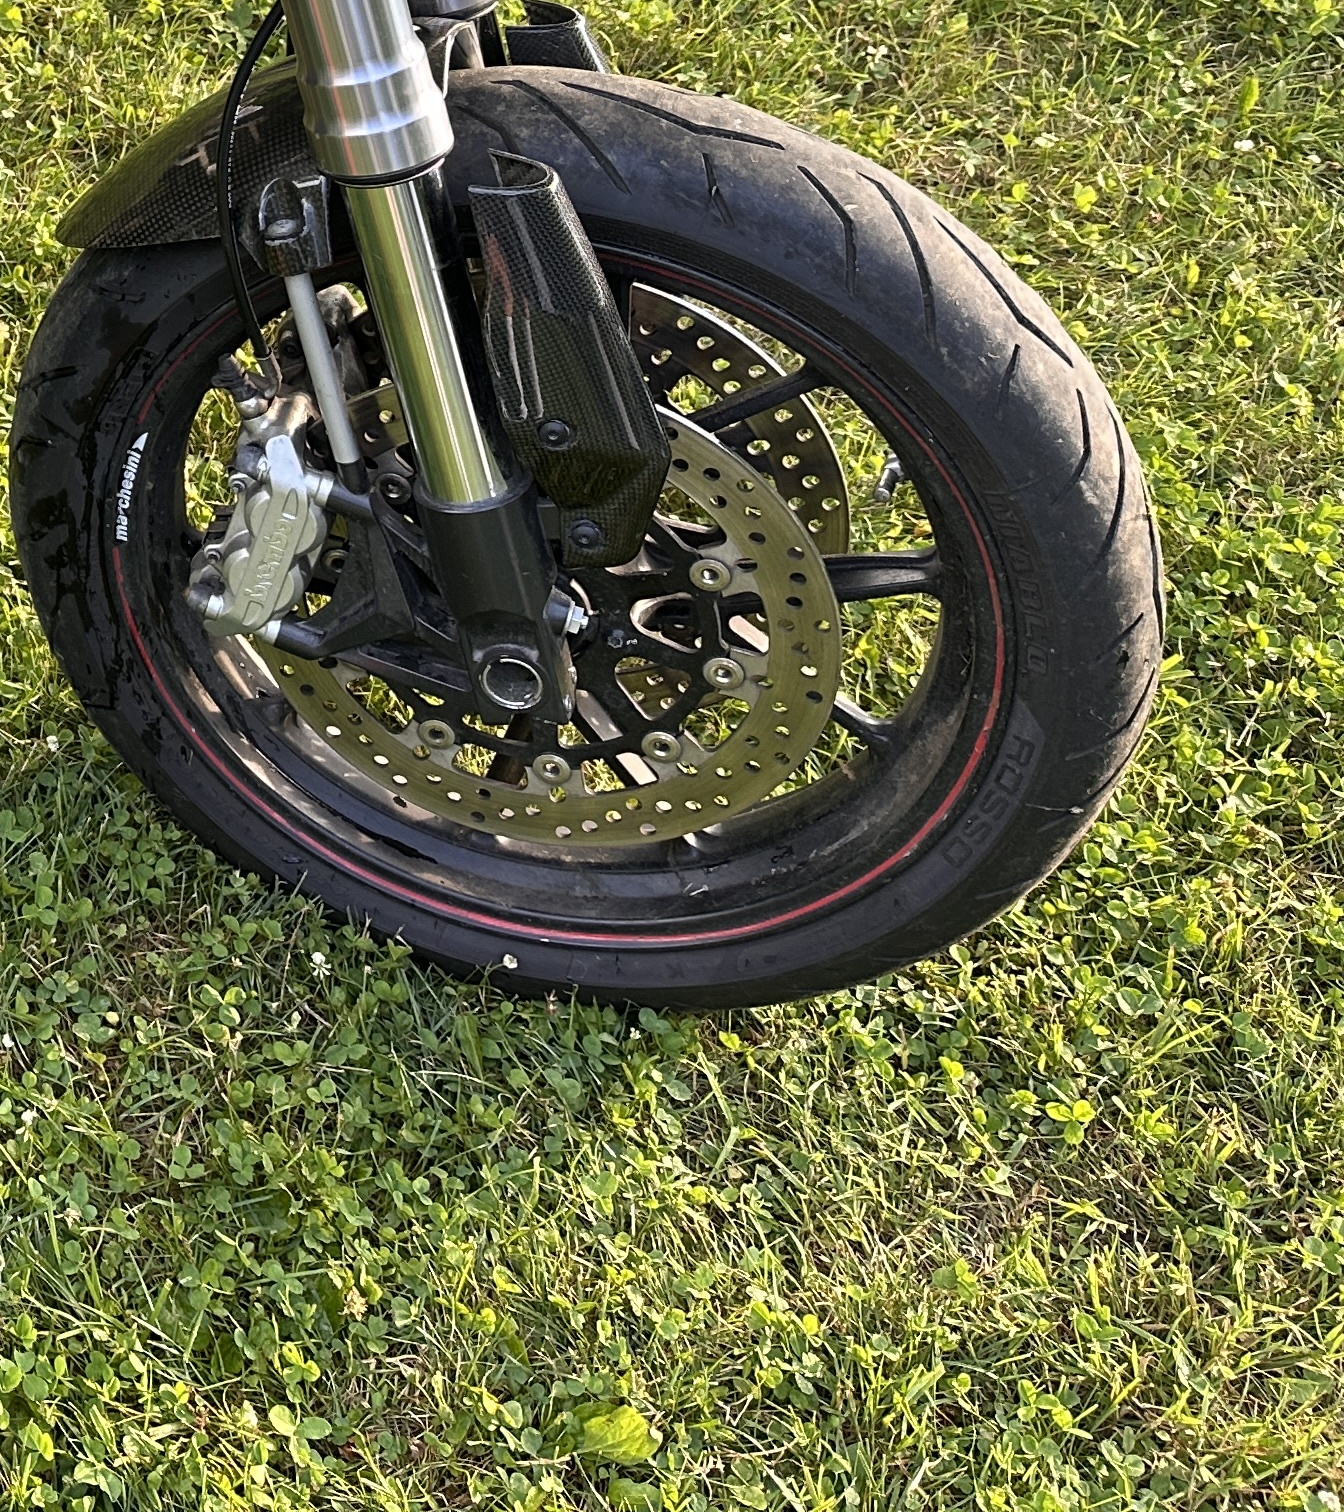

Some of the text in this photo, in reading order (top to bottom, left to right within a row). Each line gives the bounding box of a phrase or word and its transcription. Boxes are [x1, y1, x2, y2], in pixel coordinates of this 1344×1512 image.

[115, 449, 143, 542] marchesini
[244, 517, 294, 604] brembo
[944, 737, 1037, 866] ROSSO
